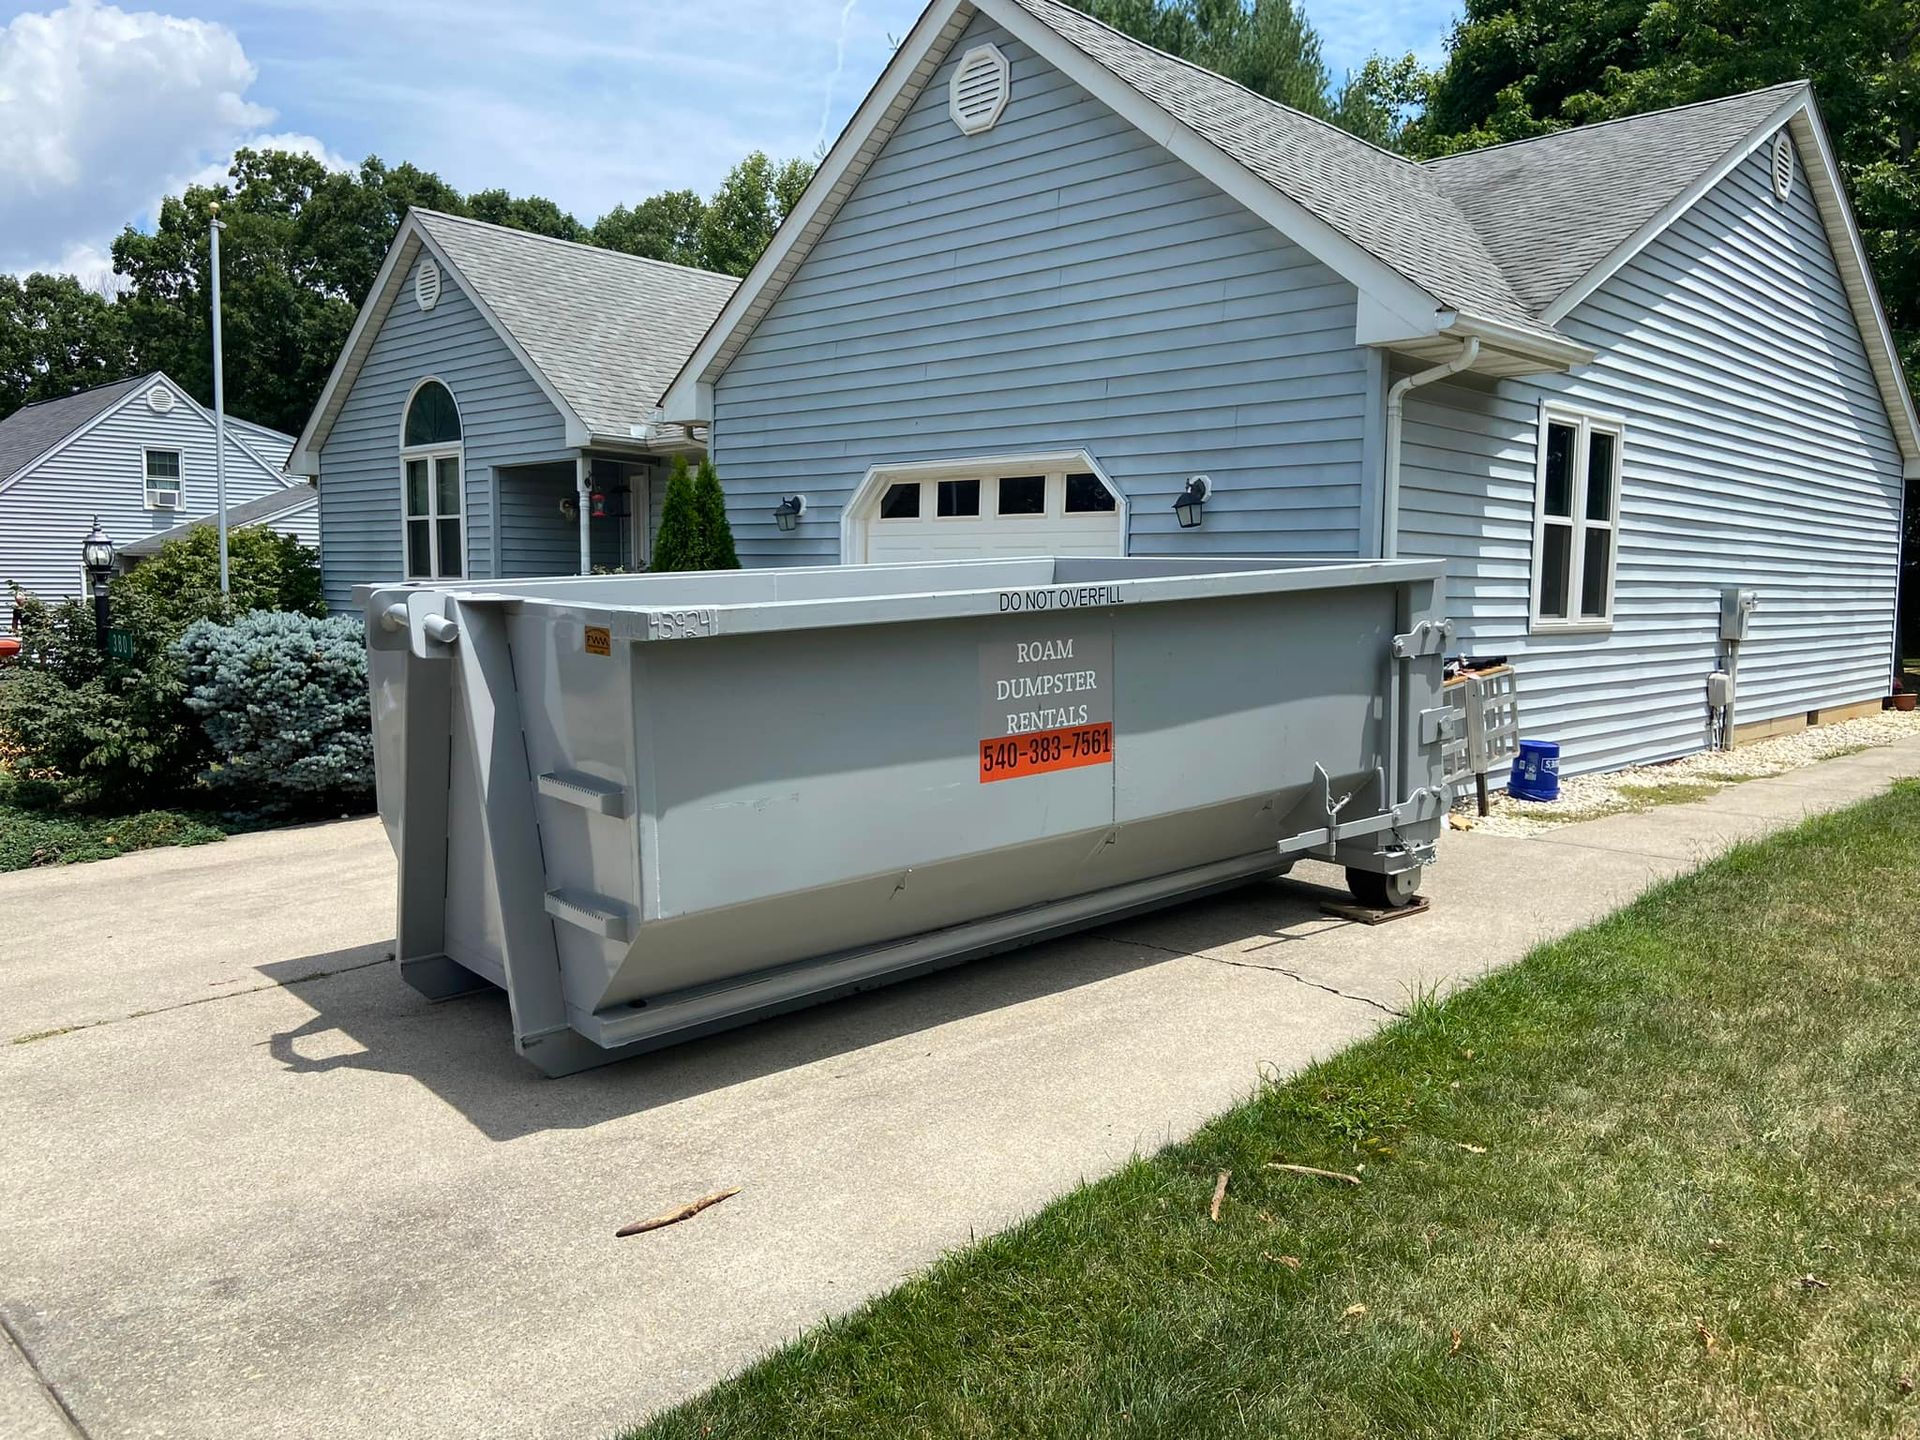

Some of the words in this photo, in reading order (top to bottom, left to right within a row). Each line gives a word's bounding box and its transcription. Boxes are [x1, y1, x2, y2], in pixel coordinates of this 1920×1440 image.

[1000, 592, 1021, 611] DO
[1026, 591, 1055, 609] NOT
[1059, 586, 1124, 607] OVERFILL
[112, 633, 128, 653] 380
[1017, 639, 1074, 663] ROAM
[996, 670, 1097, 700] DUMPSTER
[1006, 705, 1088, 734] RENTALS
[983, 728, 1111, 772] 540-383-7561
